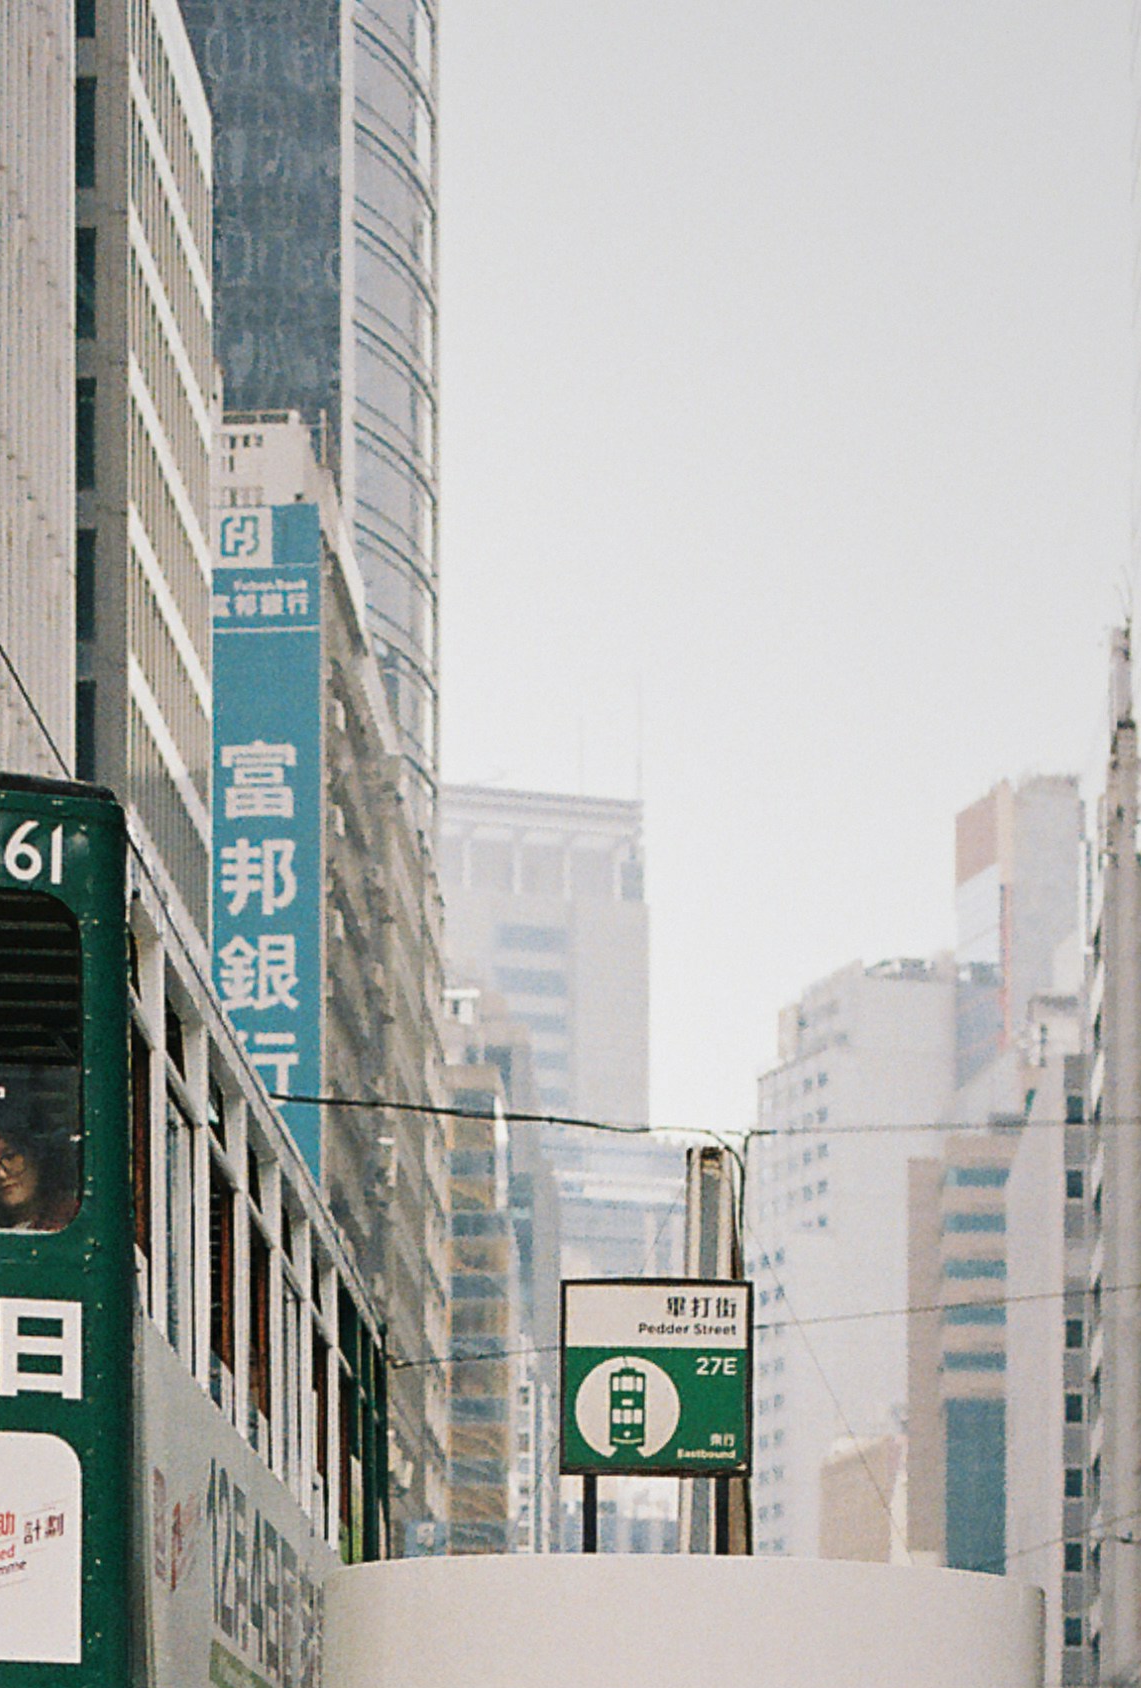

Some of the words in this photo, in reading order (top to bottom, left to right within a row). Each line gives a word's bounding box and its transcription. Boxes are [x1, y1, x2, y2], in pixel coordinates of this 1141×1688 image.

[638, 1322, 690, 1335] Pedder
[693, 1322, 737, 1336] Street
[696, 1356, 738, 1376] 27E
[676, 1448, 737, 1459] Eastbound
